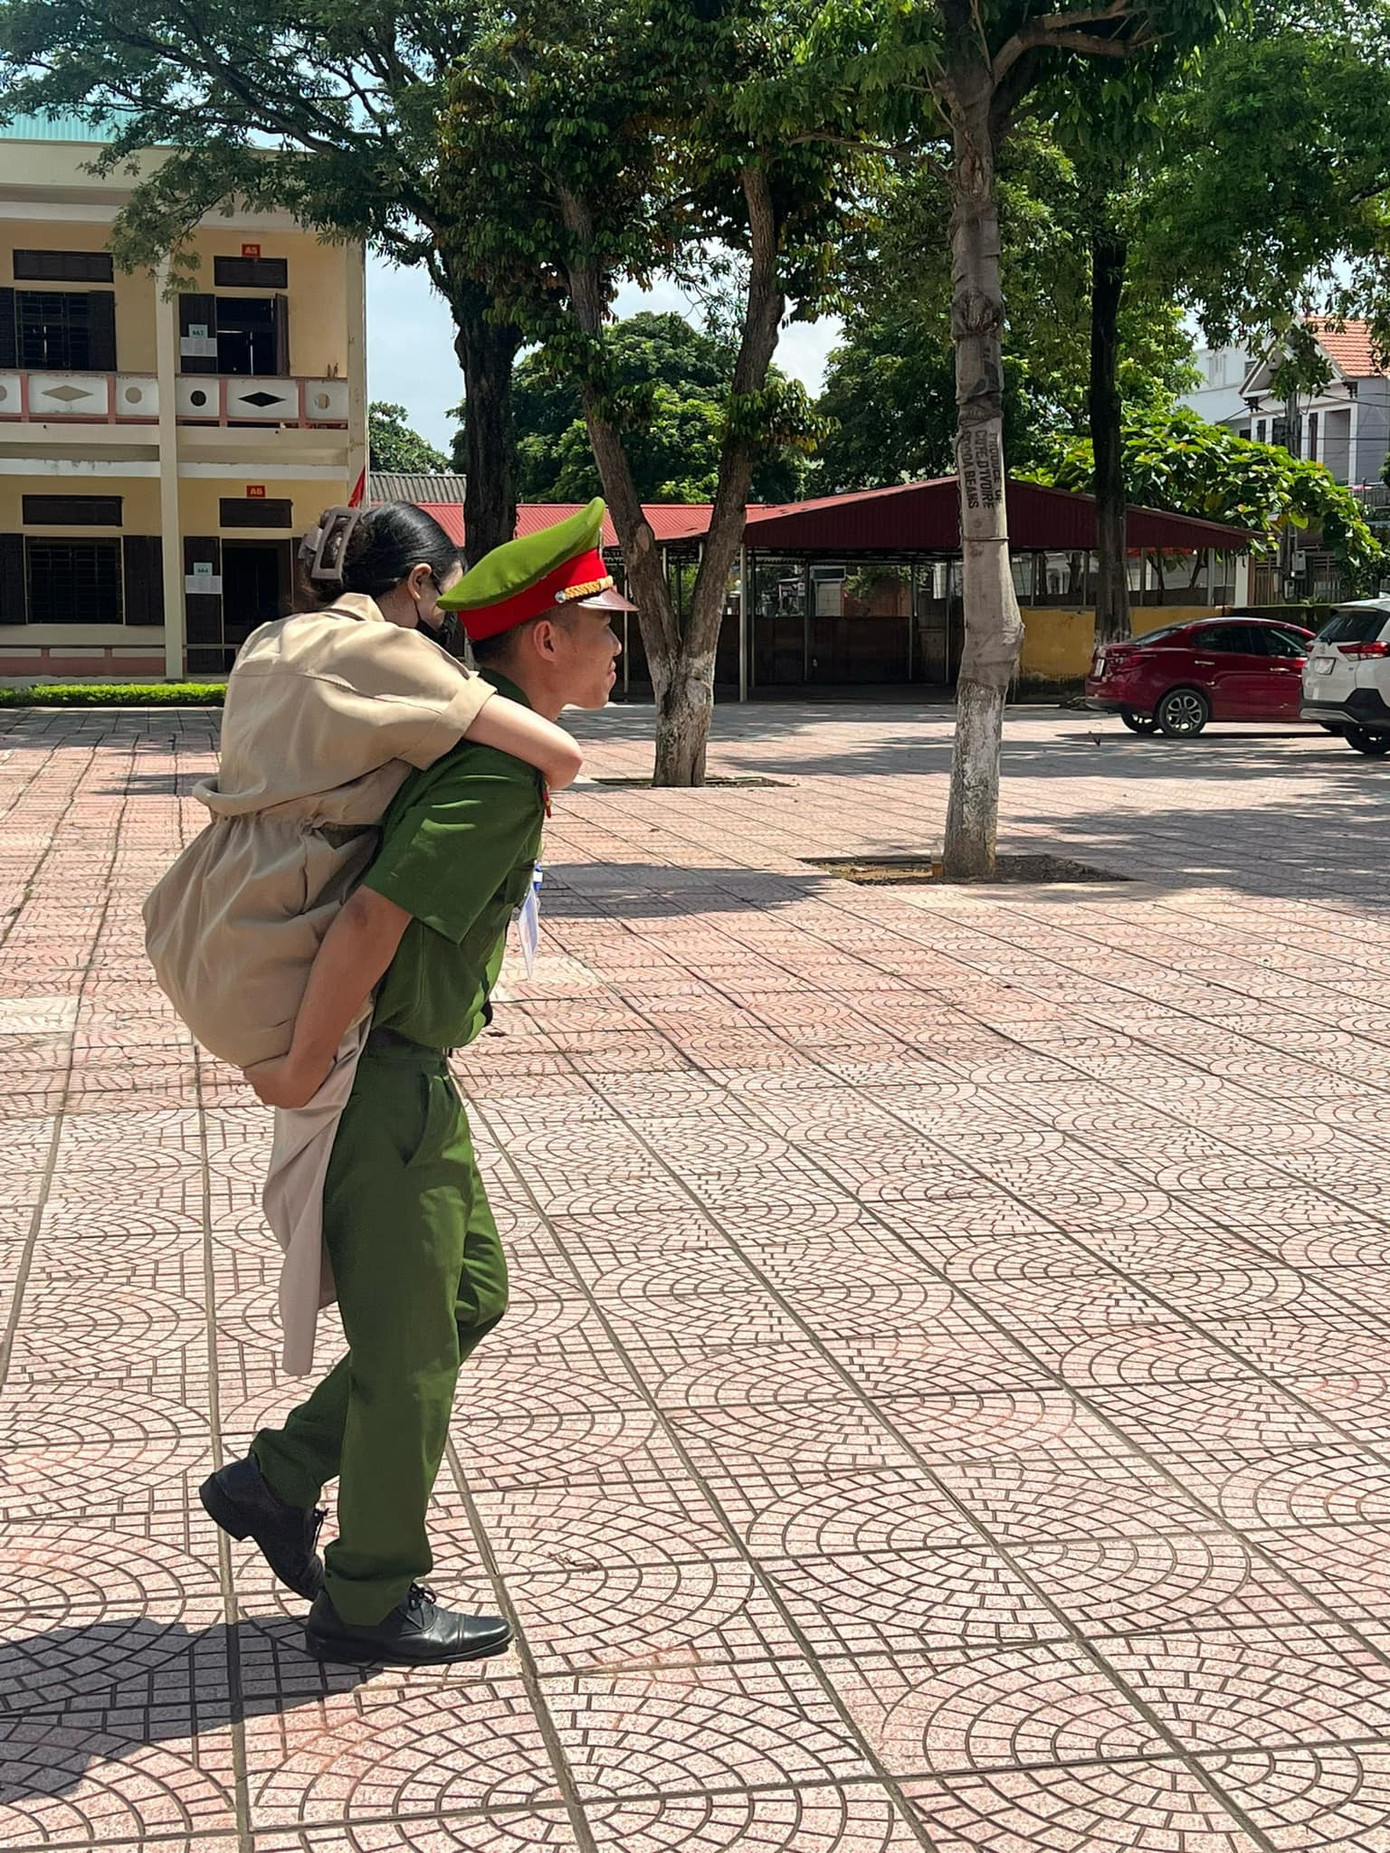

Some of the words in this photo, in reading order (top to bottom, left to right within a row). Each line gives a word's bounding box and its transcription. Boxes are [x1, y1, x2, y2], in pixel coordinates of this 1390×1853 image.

[960, 430, 974, 469] COCOA
[988, 432, 1001, 484] PRODUCE
[964, 470, 980, 510] BEANS
[977, 460, 994, 510] D'IVOIRE
